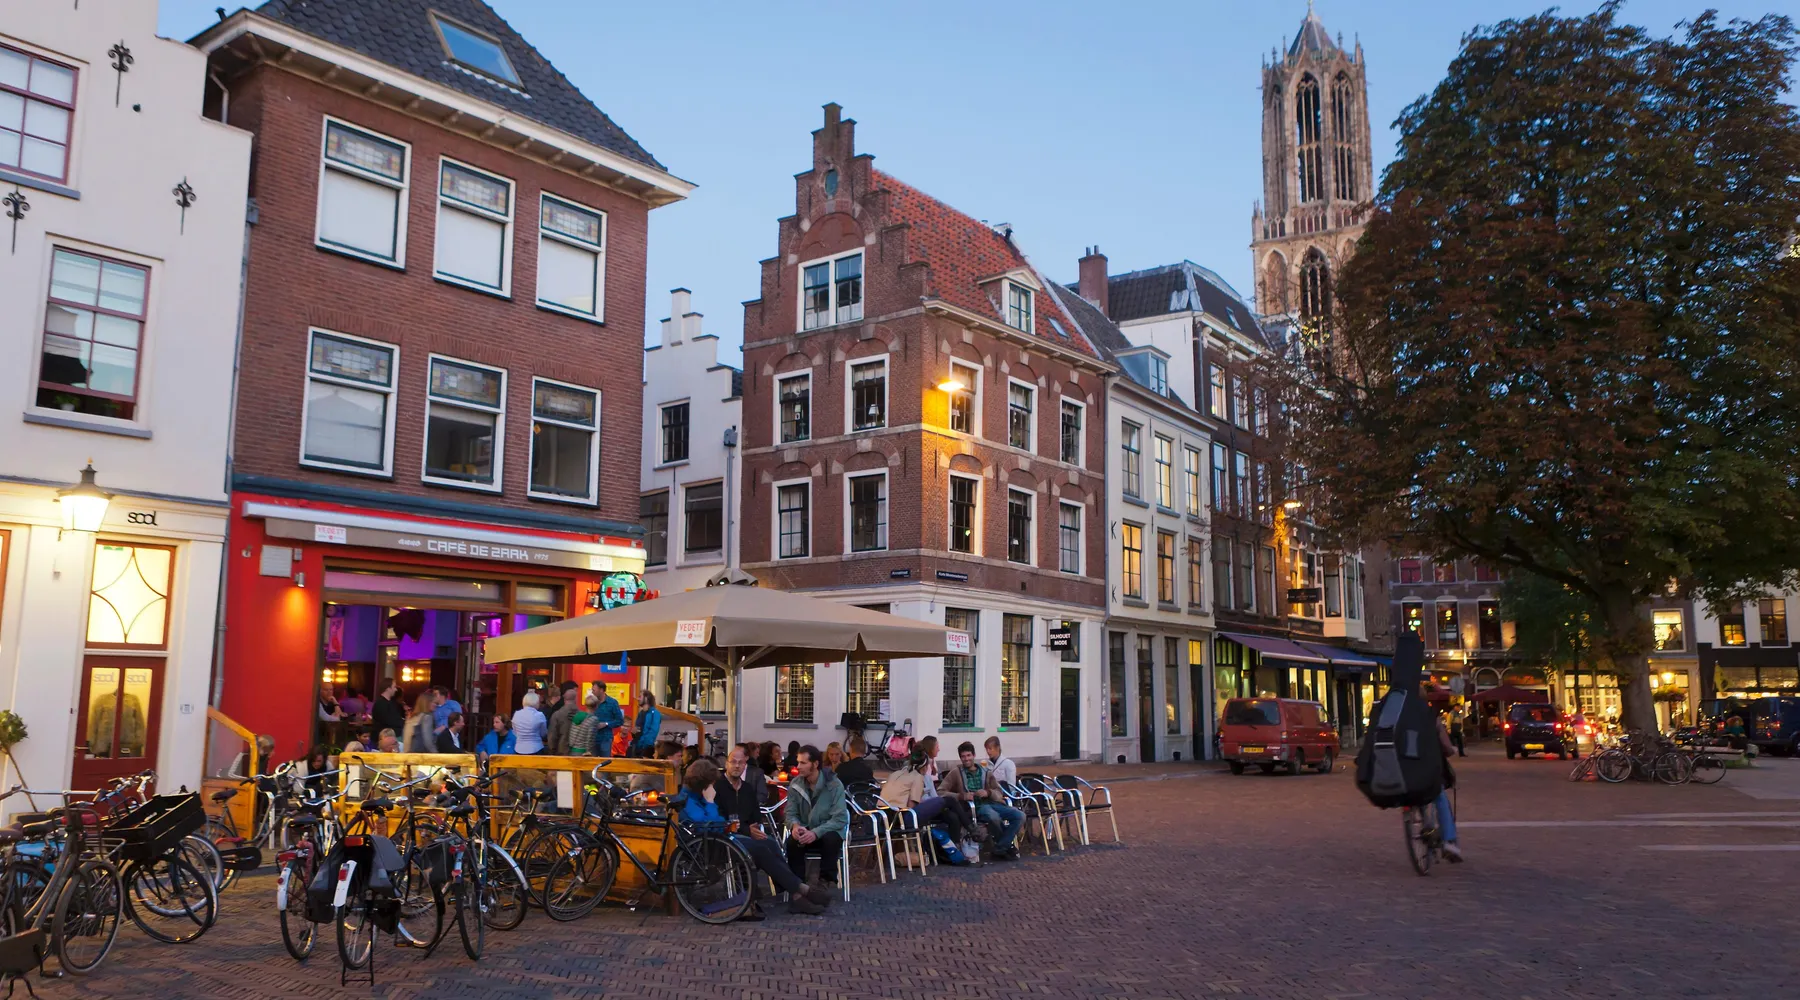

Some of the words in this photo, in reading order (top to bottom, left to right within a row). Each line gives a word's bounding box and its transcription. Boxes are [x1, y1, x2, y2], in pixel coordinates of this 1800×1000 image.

[427, 539, 467, 554] CAFÉ
[469, 544, 489, 557] DE
[491, 547, 529, 560] ZAAK
[680, 623, 704, 631] VEDETT
[948, 634, 968, 643] VEDETT
